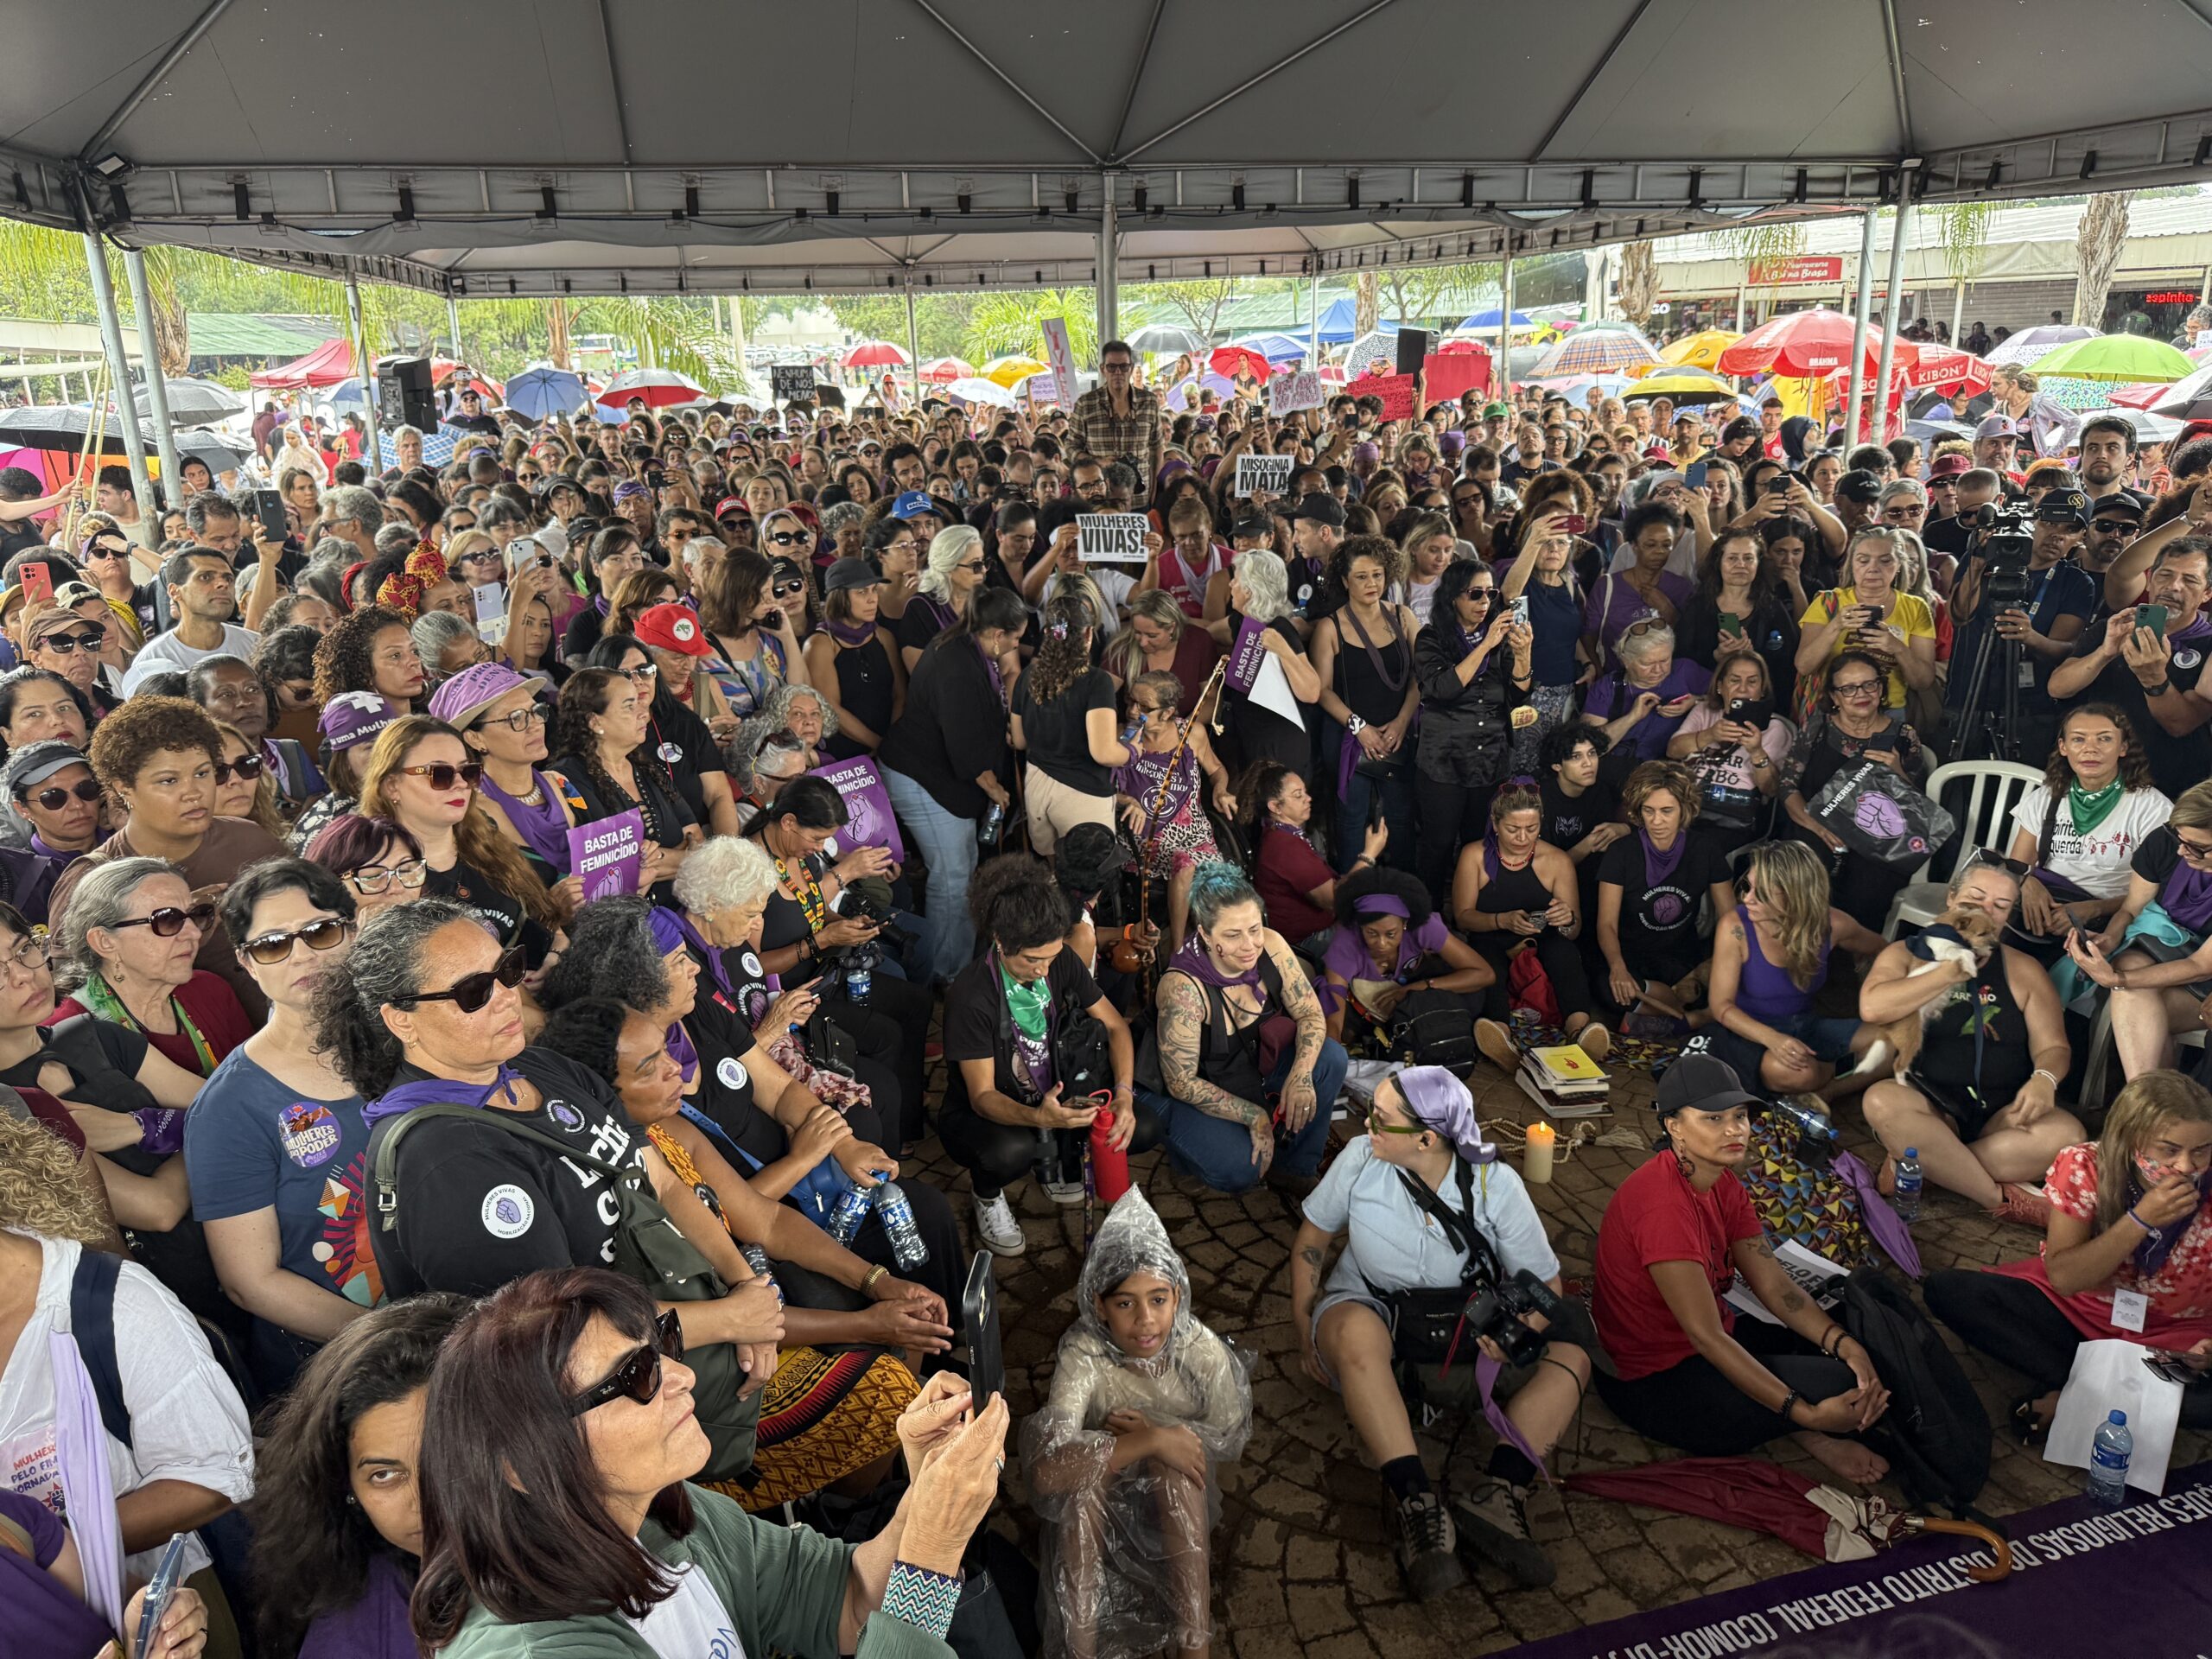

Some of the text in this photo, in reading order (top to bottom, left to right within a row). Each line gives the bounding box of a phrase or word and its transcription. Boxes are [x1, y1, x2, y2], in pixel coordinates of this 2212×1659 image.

[779, 379, 793, 390] DE
[1241, 459, 1289, 471] MISOGINIA
[1239, 472, 1287, 492] MATA
[1080, 516, 1146, 529] MULHERES
[1081, 529, 1146, 554] VIVAS!
[1234, 632, 1257, 678] BASTA DE
[335, 732, 357, 743] uma
[854, 765, 868, 776] DE
[837, 775, 876, 795] MINICÍDIO
[1820, 762, 1874, 817] MULHERES VIVAS
[584, 826, 633, 854] BASTA DE
[581, 841, 639, 874] FEMINICÍDIO
[1642, 886, 1675, 901] MULHERES
[484, 909, 514, 928] VIVAS
[749, 982, 767, 991] VIVA
[285, 1124, 336, 1151] MULHERES
[299, 1134, 339, 1156] PODER
[485, 1192, 499, 1220] MULHERES
[498, 1219, 529, 1236] MOBILIZAÇÃO
[11, 1465, 36, 1484] PELO
[2027, 1503, 2176, 1560] RELIGIOSAS
[1767, 1580, 1895, 1633] FEDERAL
